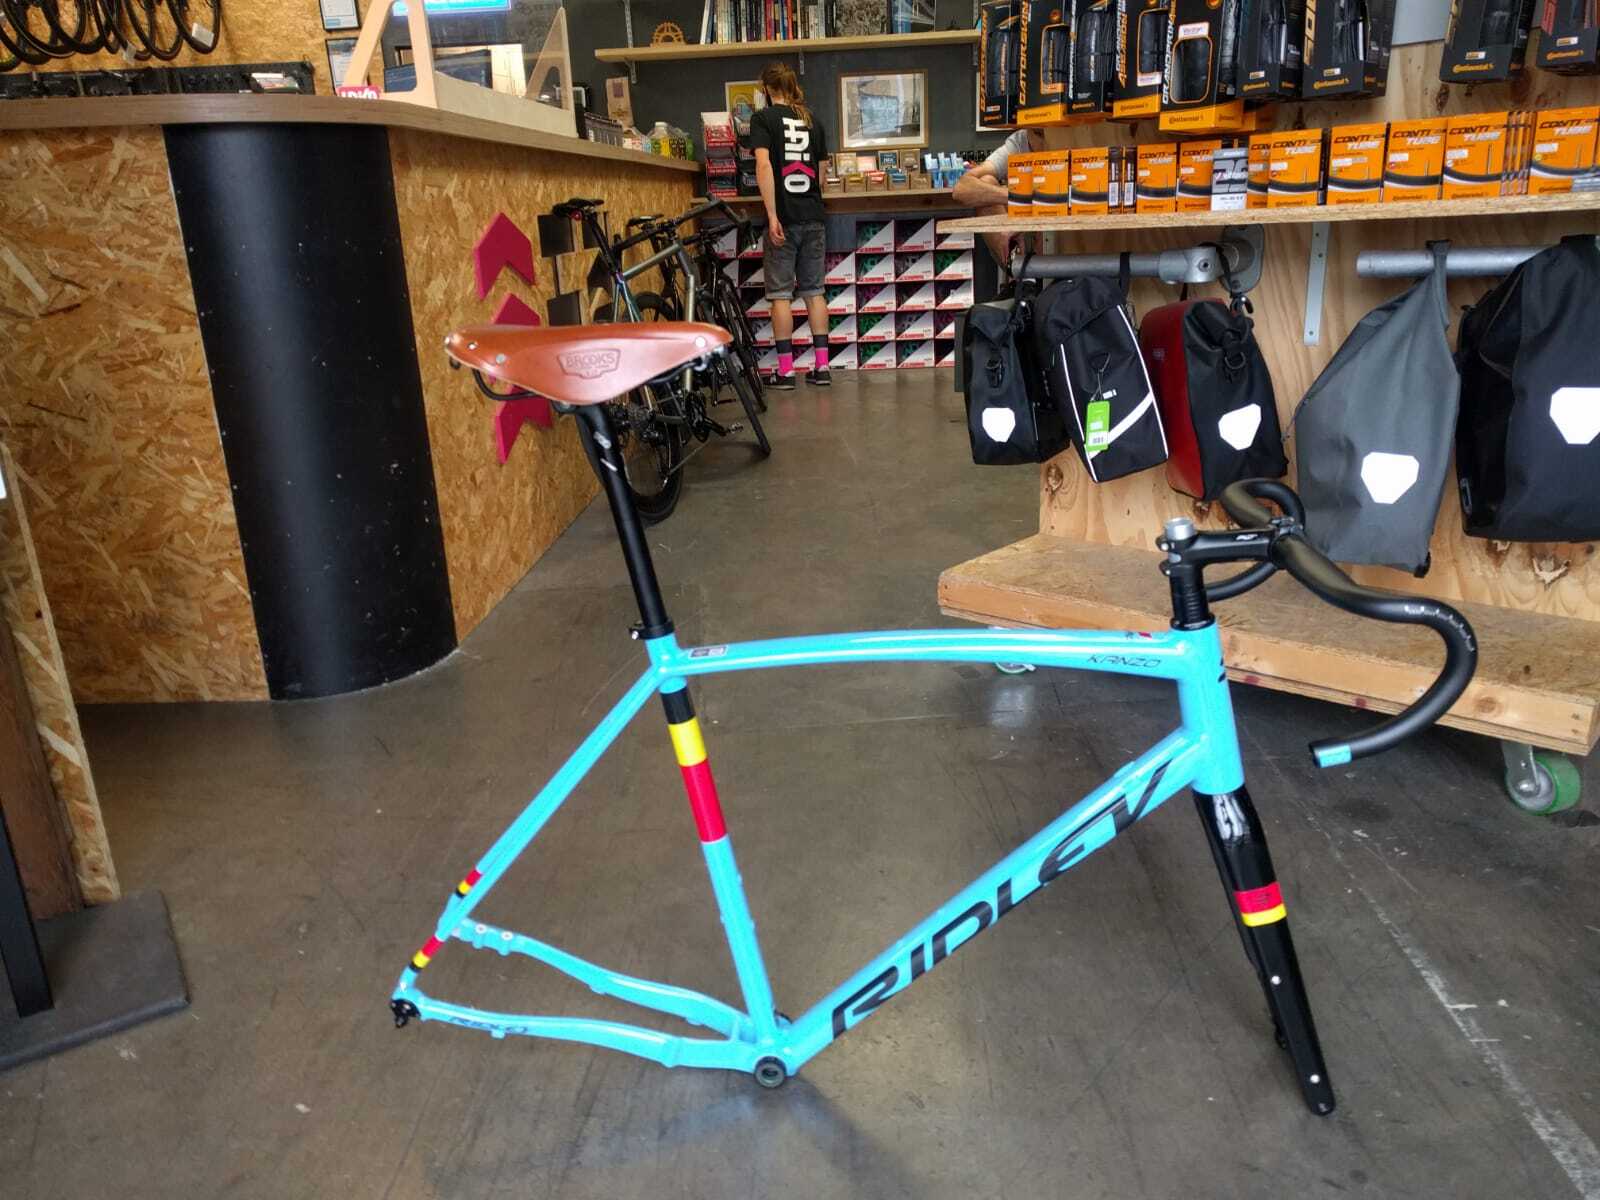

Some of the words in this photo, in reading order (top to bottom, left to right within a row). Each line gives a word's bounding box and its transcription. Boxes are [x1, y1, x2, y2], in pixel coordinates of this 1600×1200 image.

[1020, 1, 1030, 105] GATORSKIN
[1392, 129, 1431, 138] CONTI
[1449, 125, 1490, 135] CONTI
[1273, 140, 1306, 148] CONTI
[1334, 135, 1370, 144] CONTI
[566, 353, 615, 368] BROOKS
[1087, 654, 1161, 668] KANZO
[832, 758, 1173, 1041] RIDLEY
